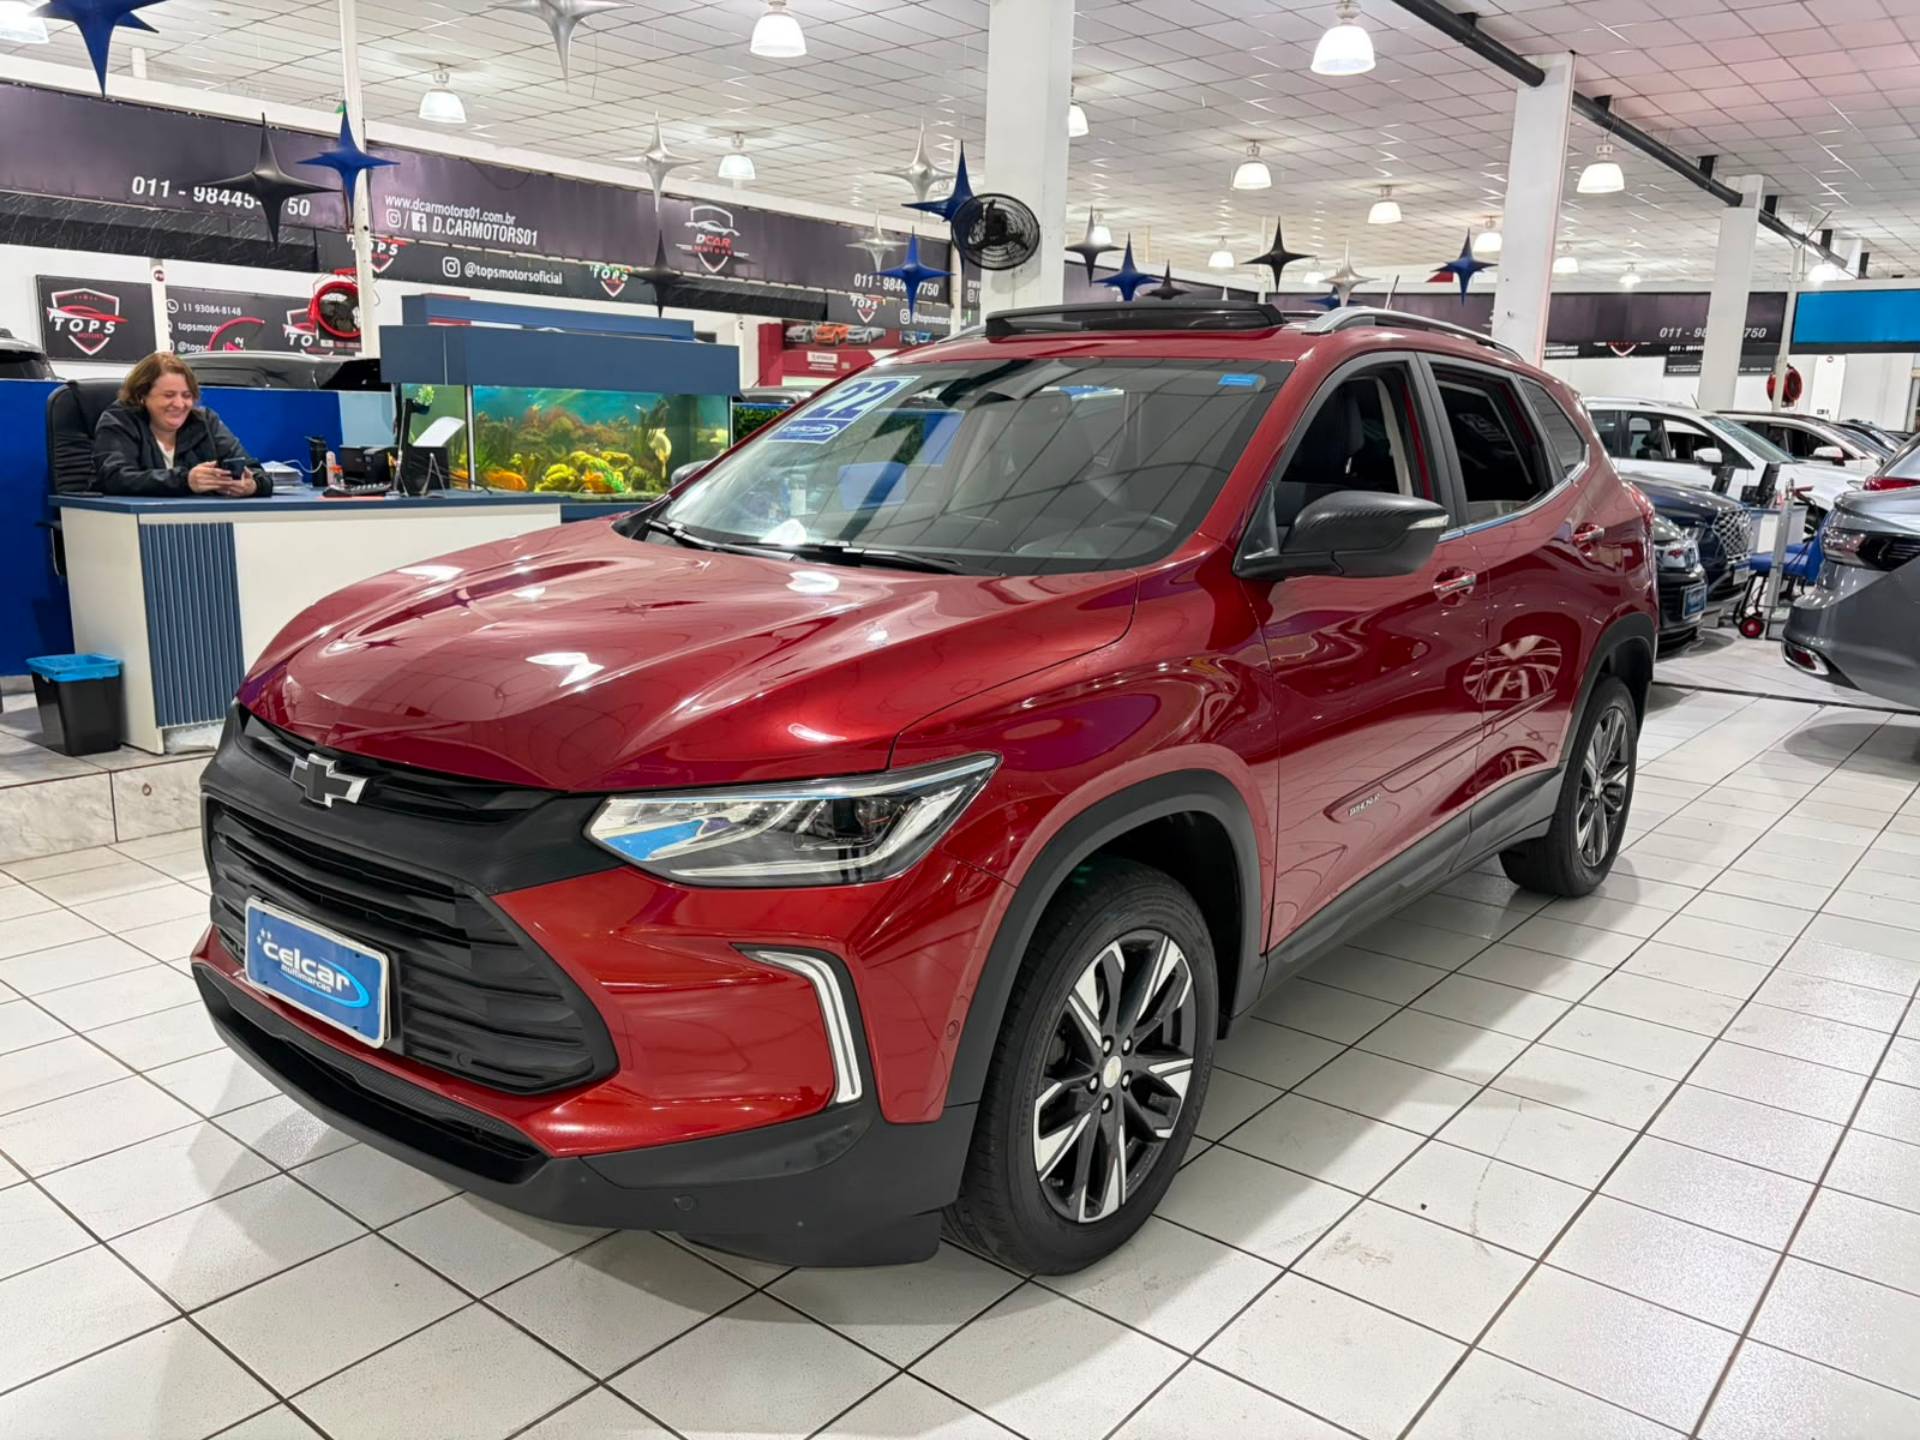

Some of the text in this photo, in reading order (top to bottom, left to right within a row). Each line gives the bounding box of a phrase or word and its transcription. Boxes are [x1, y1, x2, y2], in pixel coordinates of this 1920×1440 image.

[131, 175, 171, 198] 011
[193, 186, 310, 216] 98445-50
[384, 194, 516, 225] www.dcarmotors01.com.br
[432, 216, 538, 247] D.CARMOTORS01
[695, 233, 732, 248] DCAR
[464, 261, 563, 285] @topsmotorsoficial
[853, 273, 873, 289] 011
[183, 303, 192, 312] 11
[54, 318, 116, 335] TOPS
[1659, 327, 1683, 339] 011
[801, 380, 901, 419] 22
[263, 941, 351, 992] celcar
